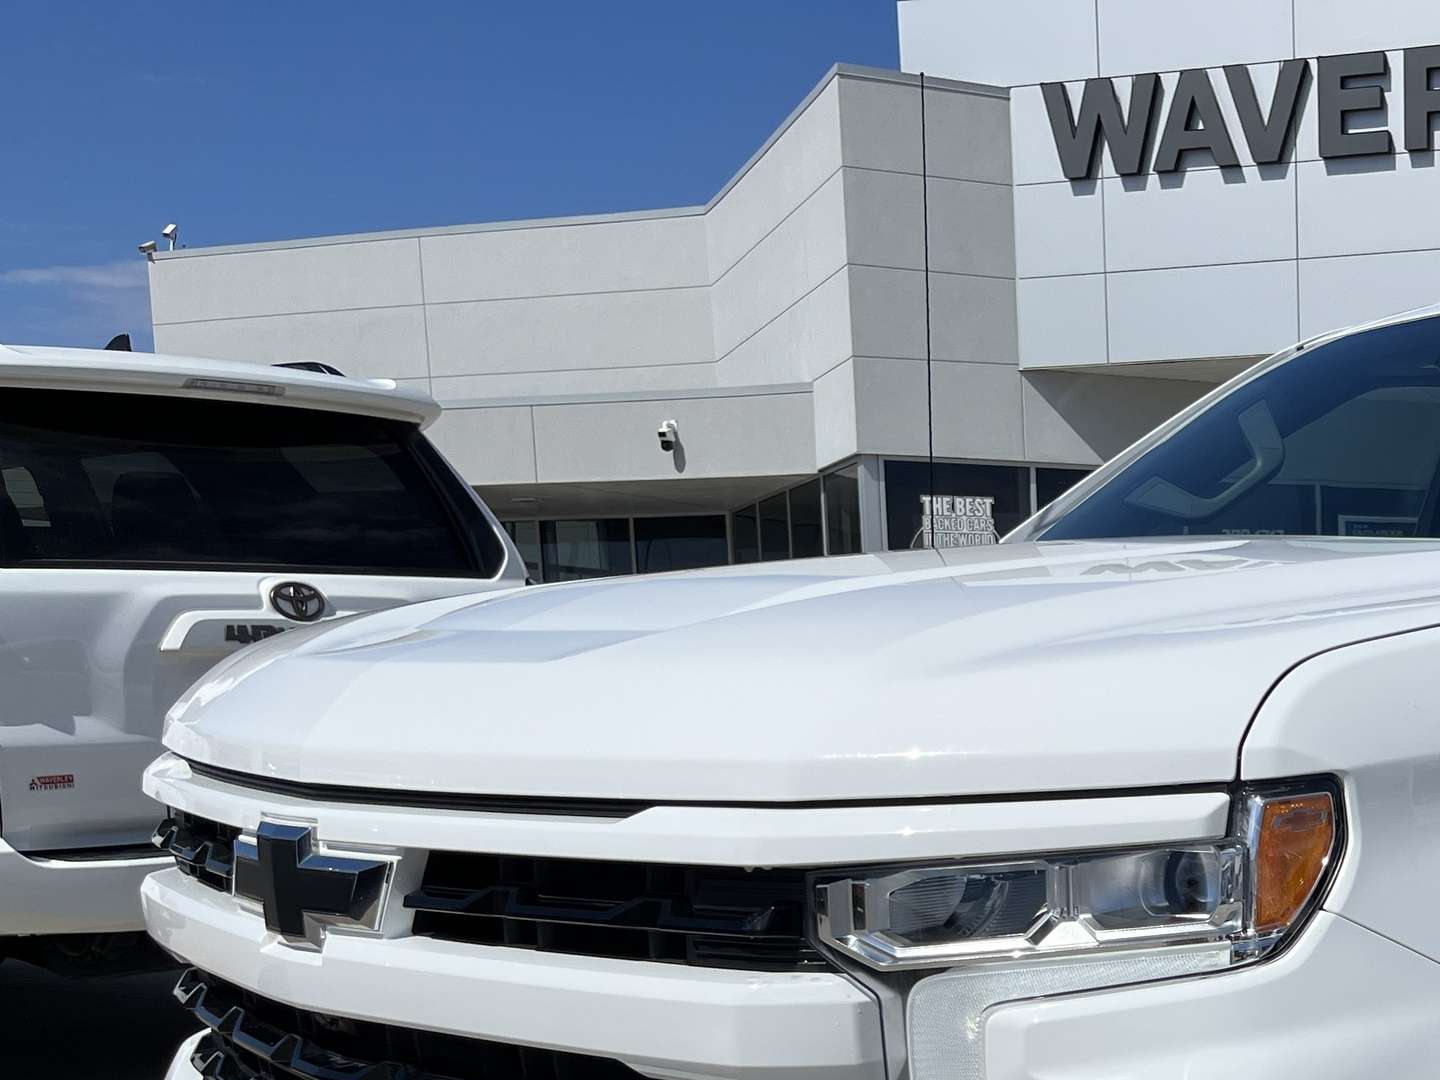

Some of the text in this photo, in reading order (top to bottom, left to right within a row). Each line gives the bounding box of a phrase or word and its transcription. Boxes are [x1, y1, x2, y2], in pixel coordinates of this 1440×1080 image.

[921, 495, 994, 517] THE BEST
[923, 516, 994, 531] BACKED CARS
